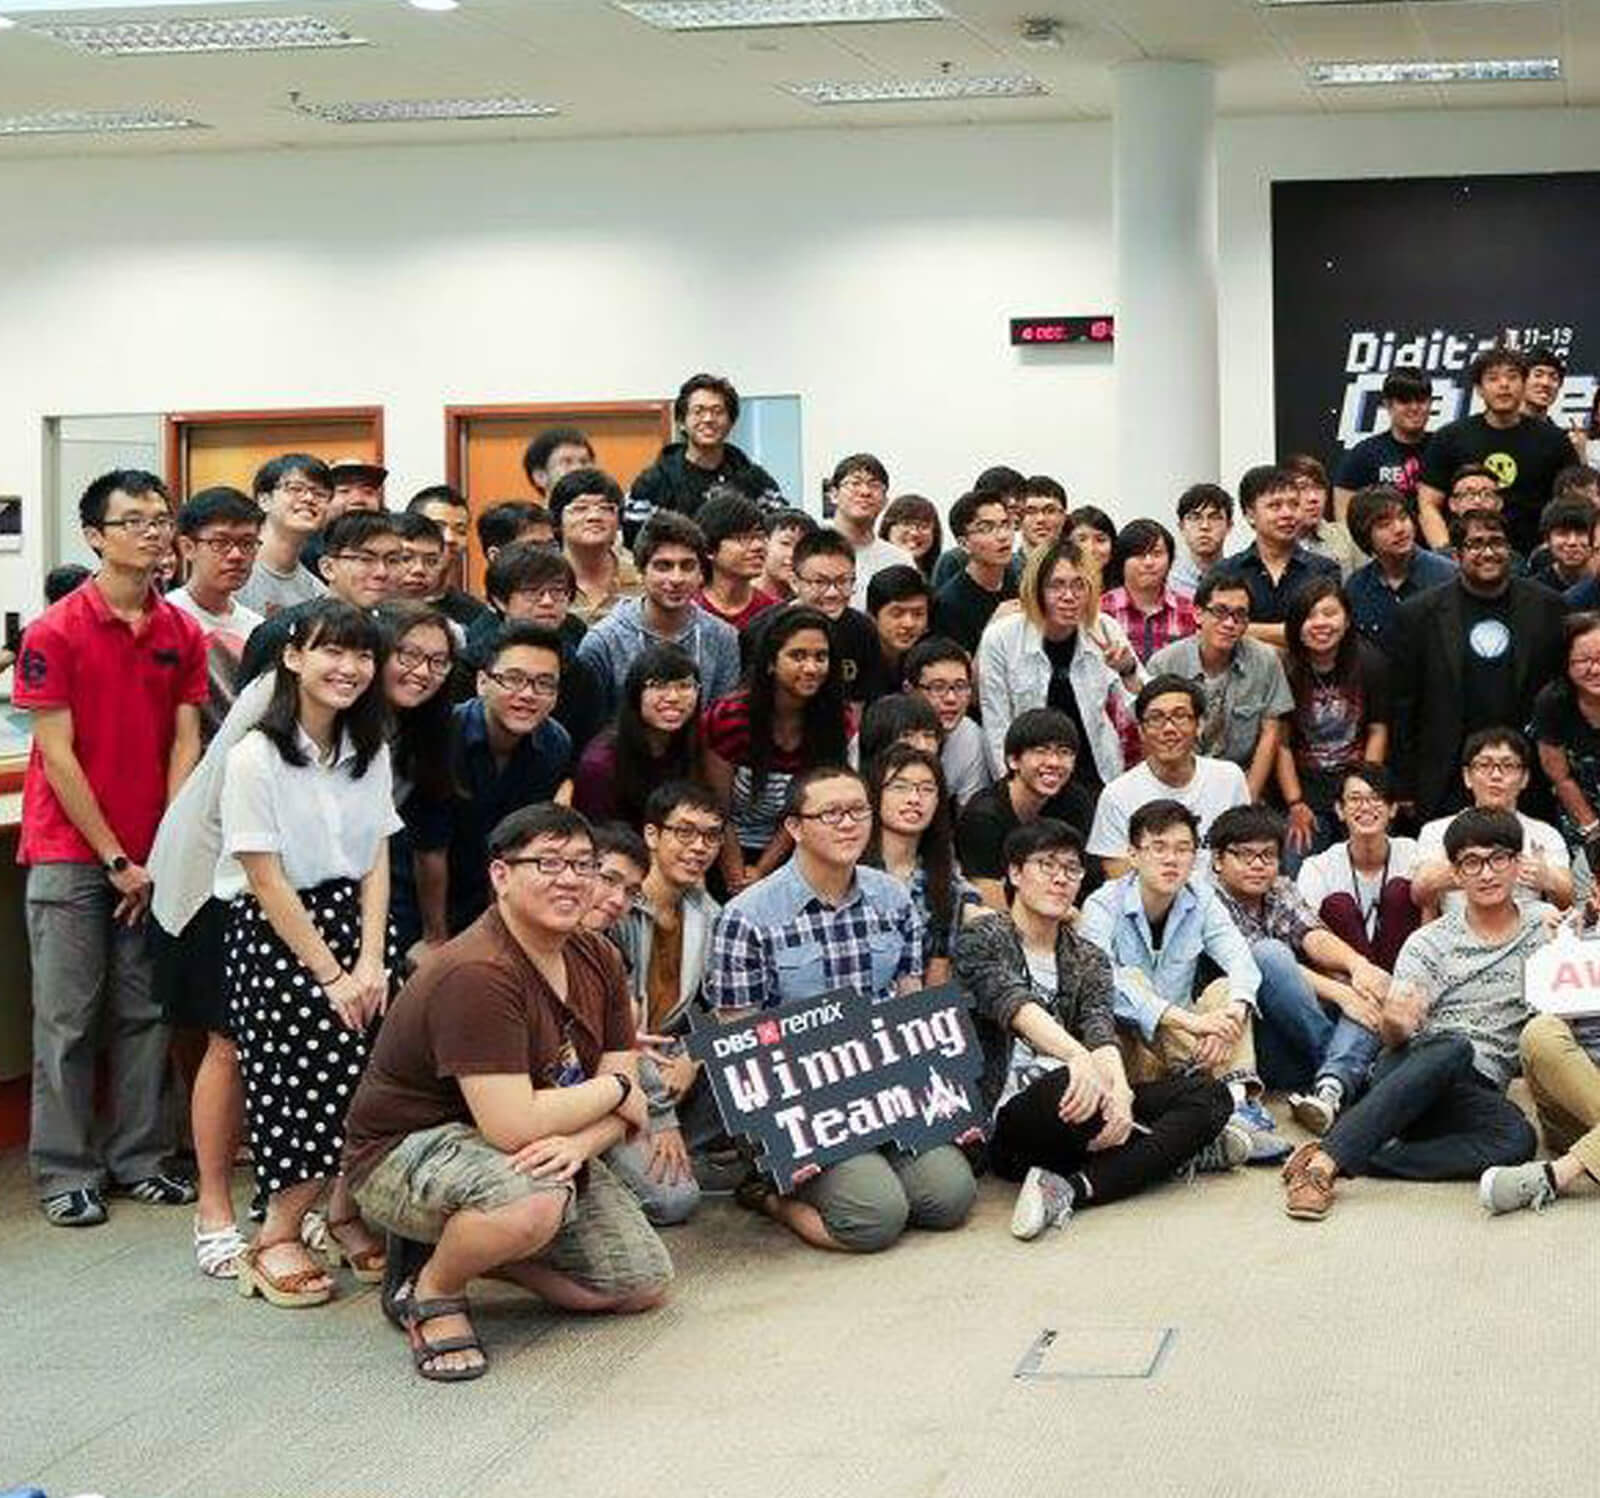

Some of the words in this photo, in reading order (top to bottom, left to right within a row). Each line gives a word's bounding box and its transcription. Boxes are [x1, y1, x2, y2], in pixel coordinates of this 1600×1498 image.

[1346, 329, 1521, 373] Digit
[1337, 370, 1598, 450] Gae
[713, 1029, 758, 1058] DBS
[780, 1000, 844, 1037] remix
[724, 1007, 967, 1113] Winning
[775, 1085, 916, 1159] Team
